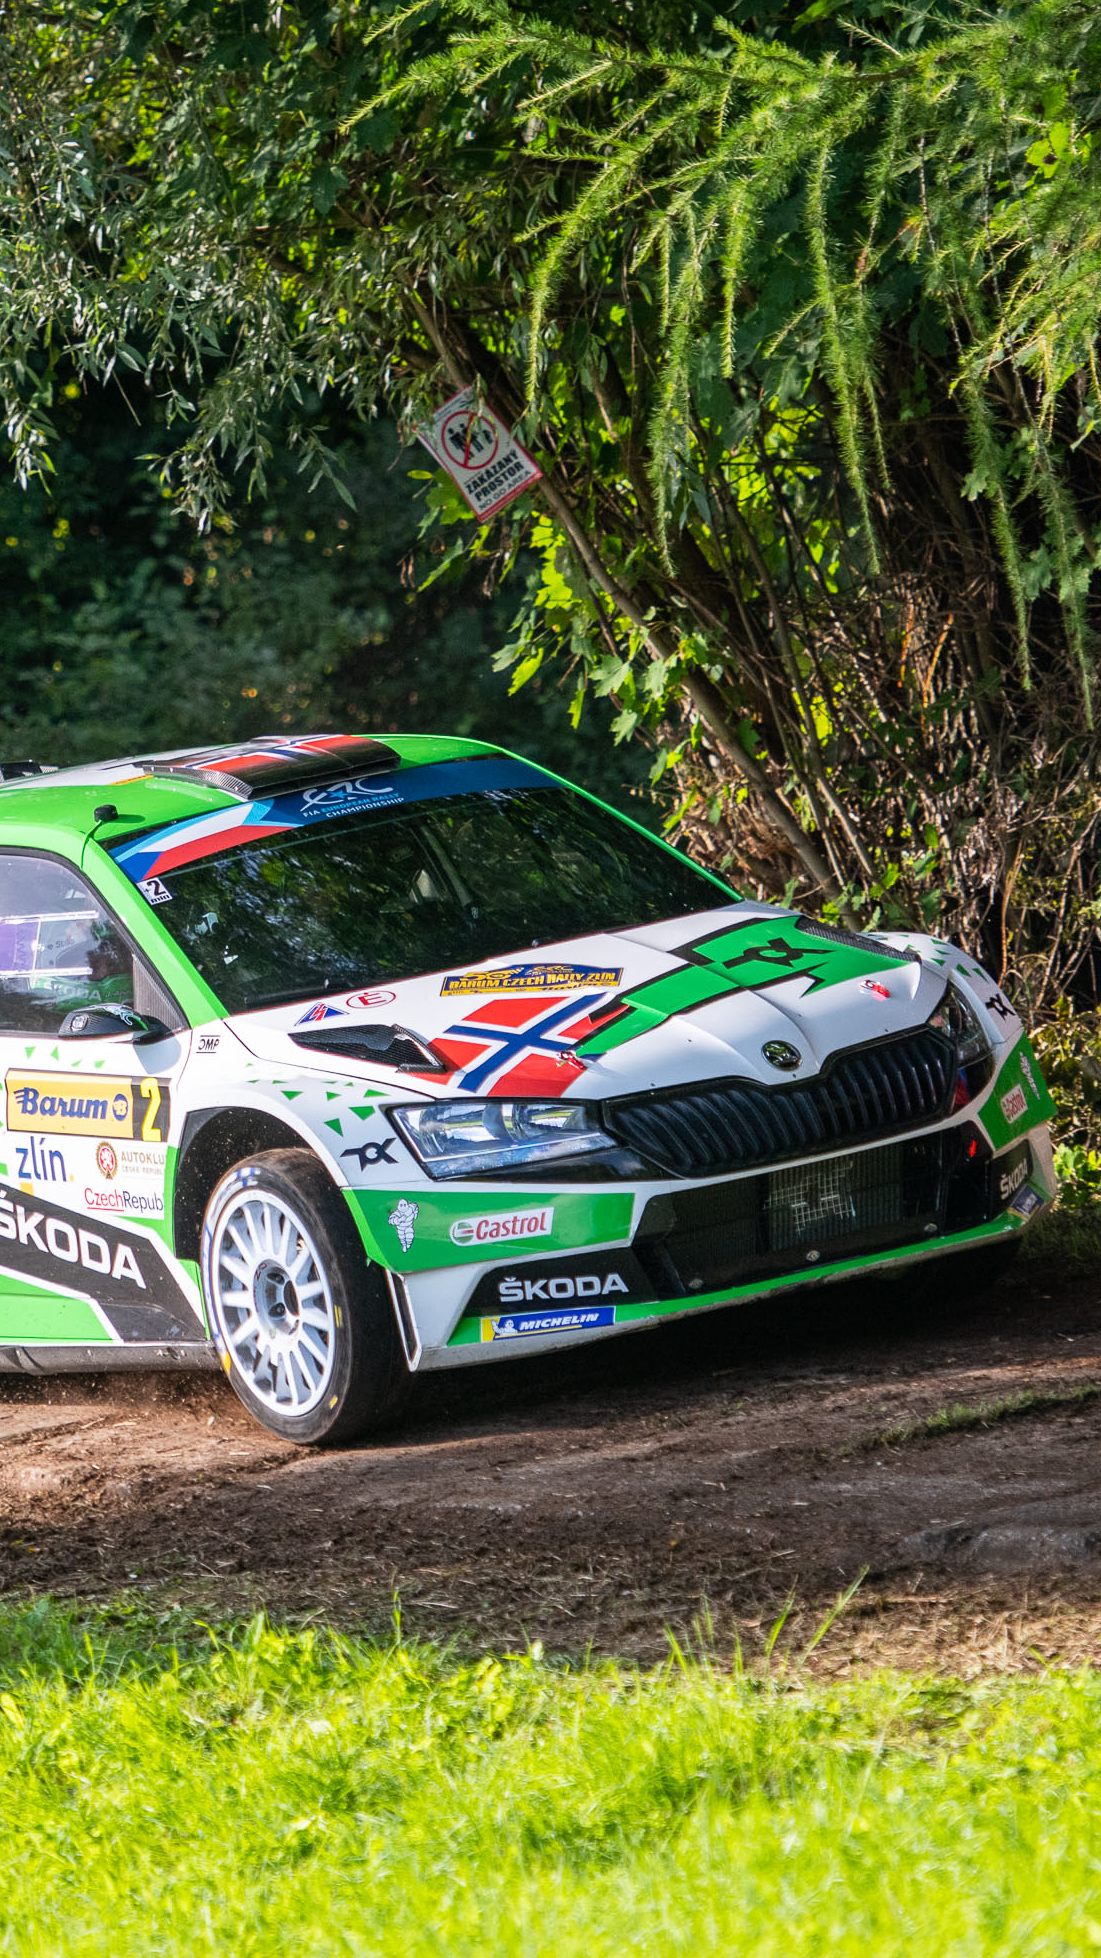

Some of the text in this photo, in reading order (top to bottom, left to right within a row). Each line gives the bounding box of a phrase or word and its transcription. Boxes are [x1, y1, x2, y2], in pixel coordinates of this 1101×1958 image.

[474, 461, 524, 502] PROSTOR
[479, 470, 532, 510] NO GO AREA
[302, 792, 399, 818] FIA EUROPEAN RALLY
[325, 797, 404, 818] CHAMPIONSHIP
[151, 894, 171, 904] min
[449, 978, 500, 989] BARUM
[502, 974, 545, 986] CZECH
[546, 972, 585, 984] RALLY
[13, 1086, 108, 1120] Barum
[140, 1076, 162, 1142] 2
[1000, 1157, 1029, 1201] ŠKODA
[475, 1211, 548, 1241] Castrol
[499, 1272, 630, 1303] ŠKODA
[518, 1312, 600, 1331] MICHELIN
